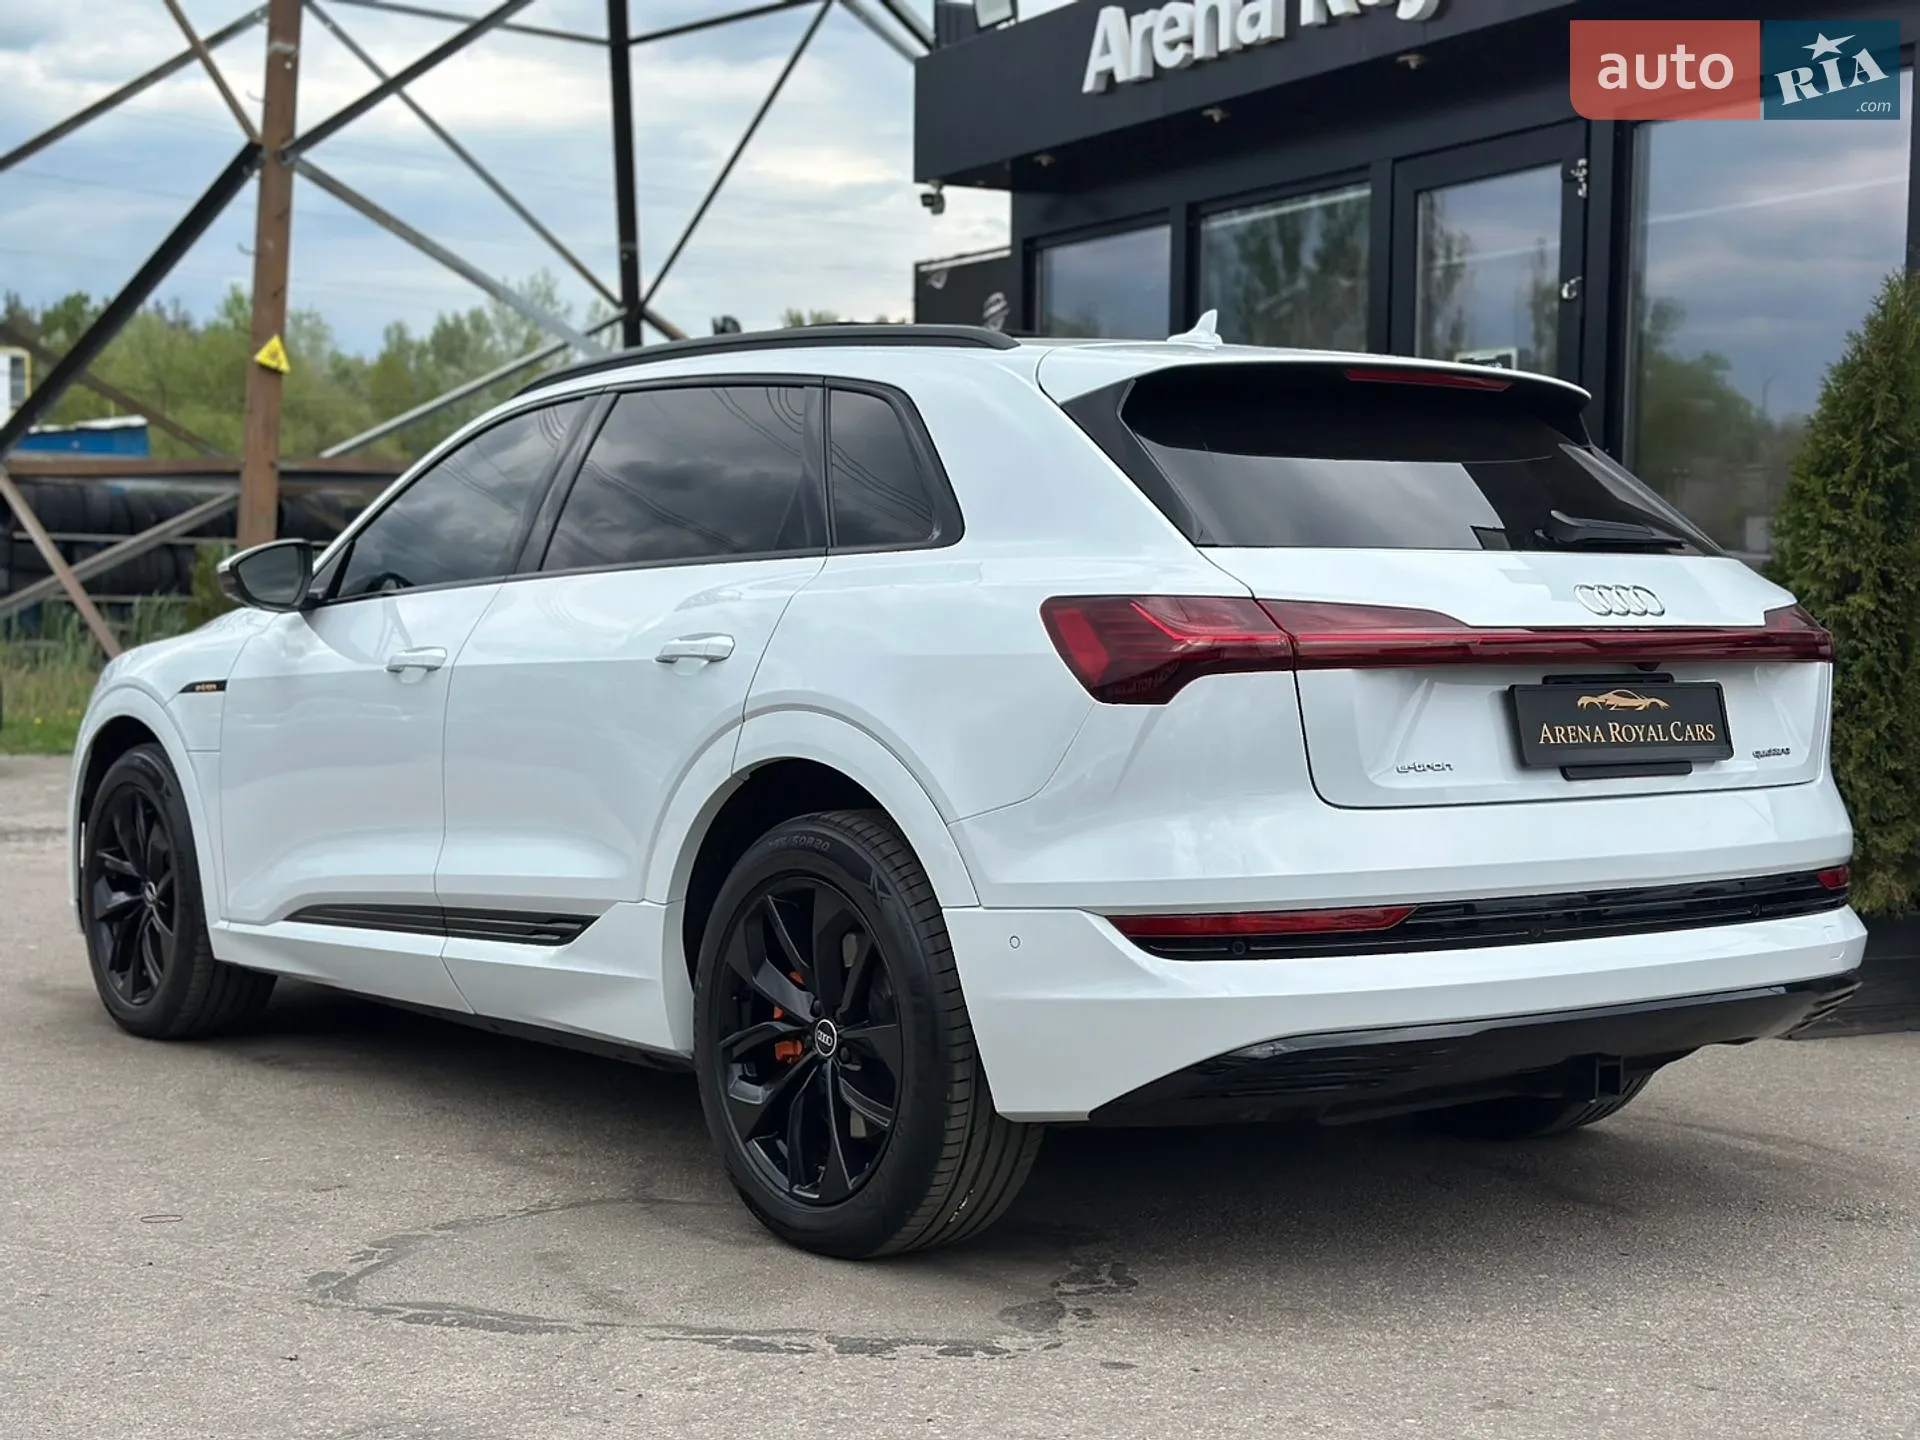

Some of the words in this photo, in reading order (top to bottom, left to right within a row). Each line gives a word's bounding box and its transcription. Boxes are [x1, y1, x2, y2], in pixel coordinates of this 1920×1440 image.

[1082, 0, 1285, 93] Arena
[1539, 723, 1606, 744] ARENA
[1608, 722, 1668, 743] ROYAL
[1670, 721, 1716, 742] CARS
